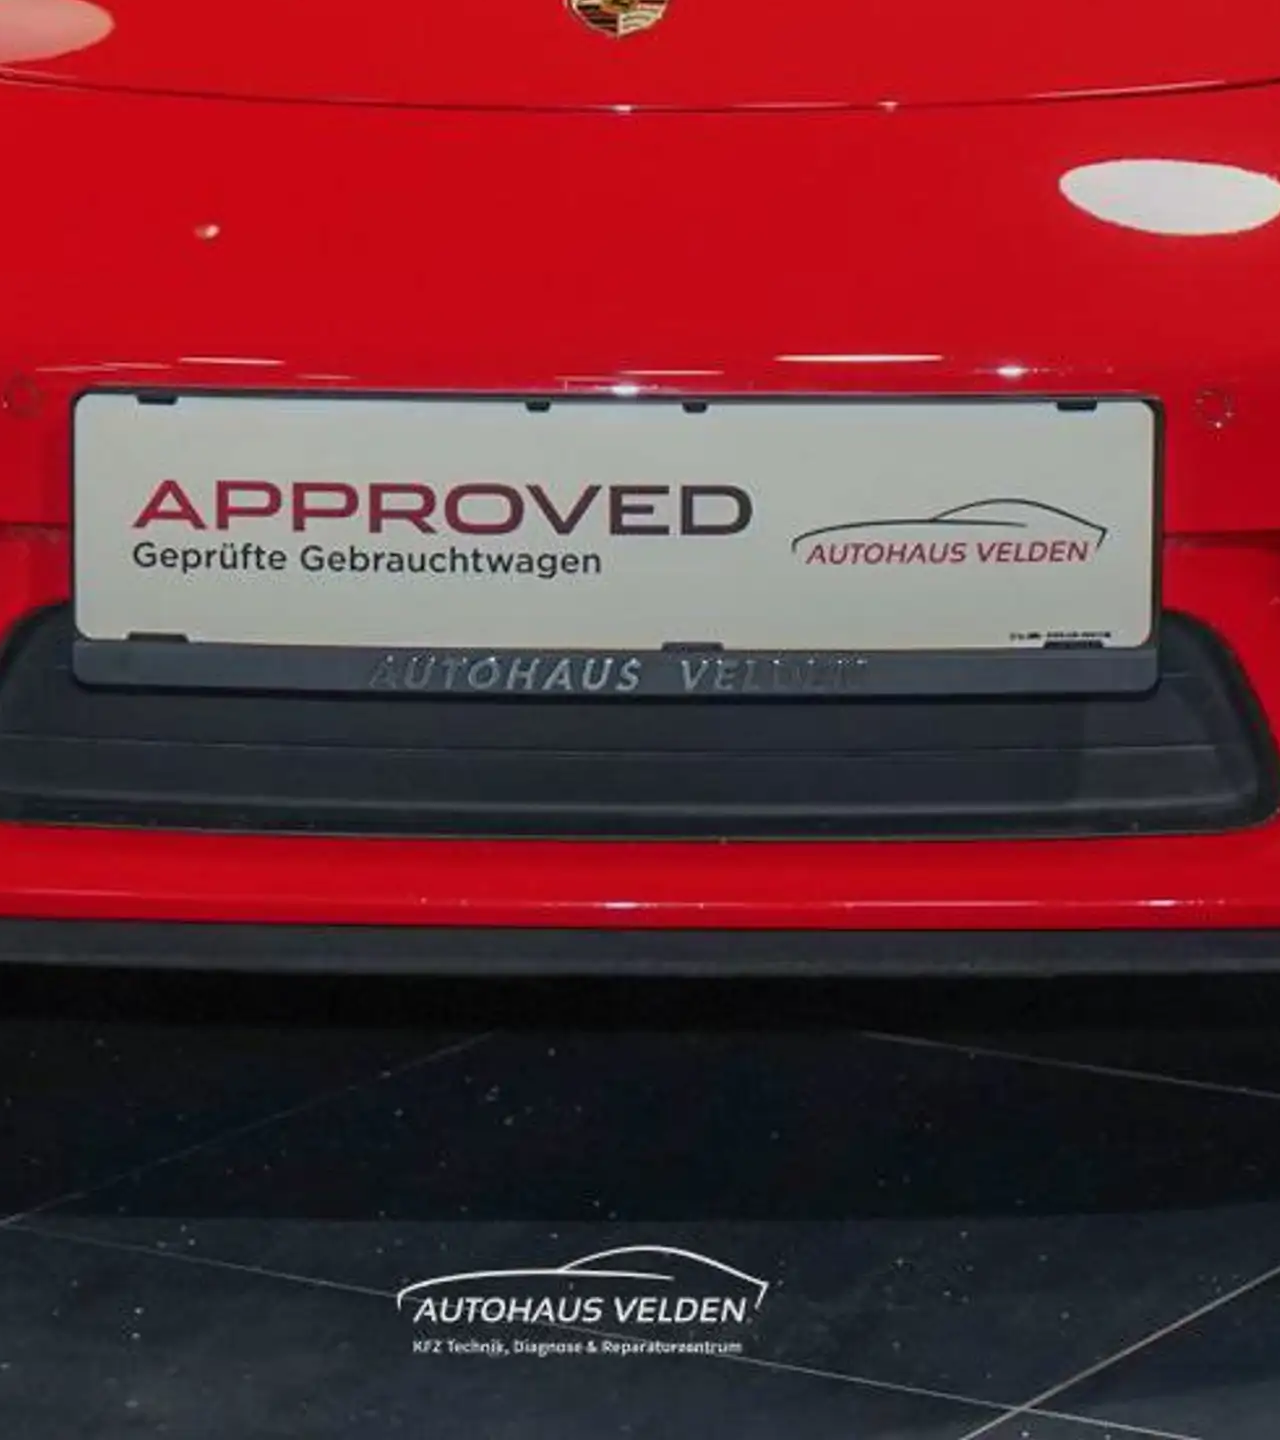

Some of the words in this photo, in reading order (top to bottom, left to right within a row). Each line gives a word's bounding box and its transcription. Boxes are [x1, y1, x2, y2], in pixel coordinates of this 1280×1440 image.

[132, 478, 753, 538] APPROVED
[132, 541, 288, 574] Geprüfte
[300, 544, 602, 579] Gebrauchtwagen
[805, 541, 967, 565] AUTOHAUS
[976, 539, 1090, 563] VELDEN
[368, 656, 643, 692] AUTOHAUS
